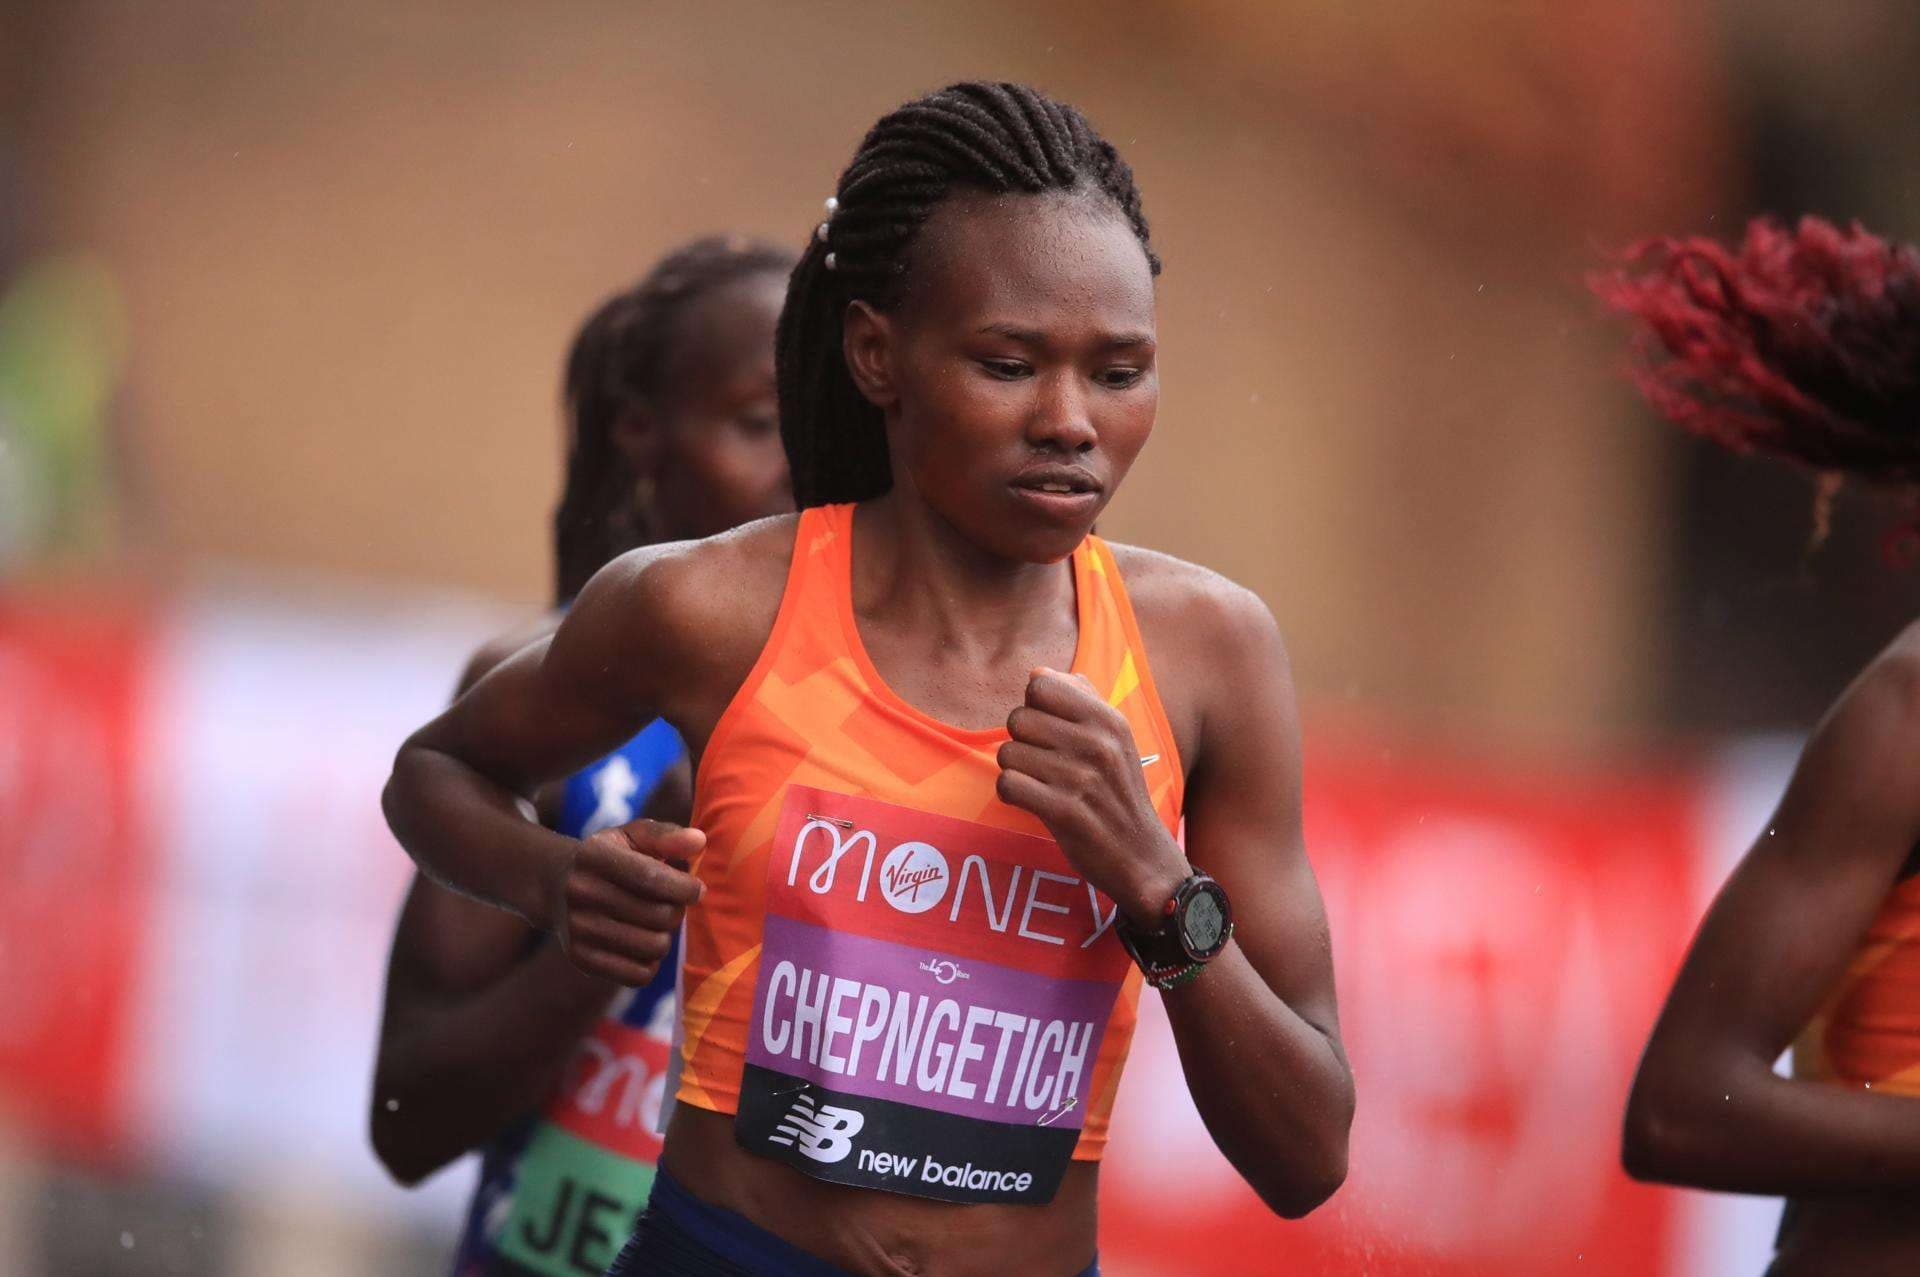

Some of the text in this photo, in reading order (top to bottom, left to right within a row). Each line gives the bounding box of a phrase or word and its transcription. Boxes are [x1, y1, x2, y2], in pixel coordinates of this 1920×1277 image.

[886, 850, 944, 903] Virgin
[762, 960, 1094, 1111] CHEPNGETICH
[857, 1149, 1033, 1192] new balance
